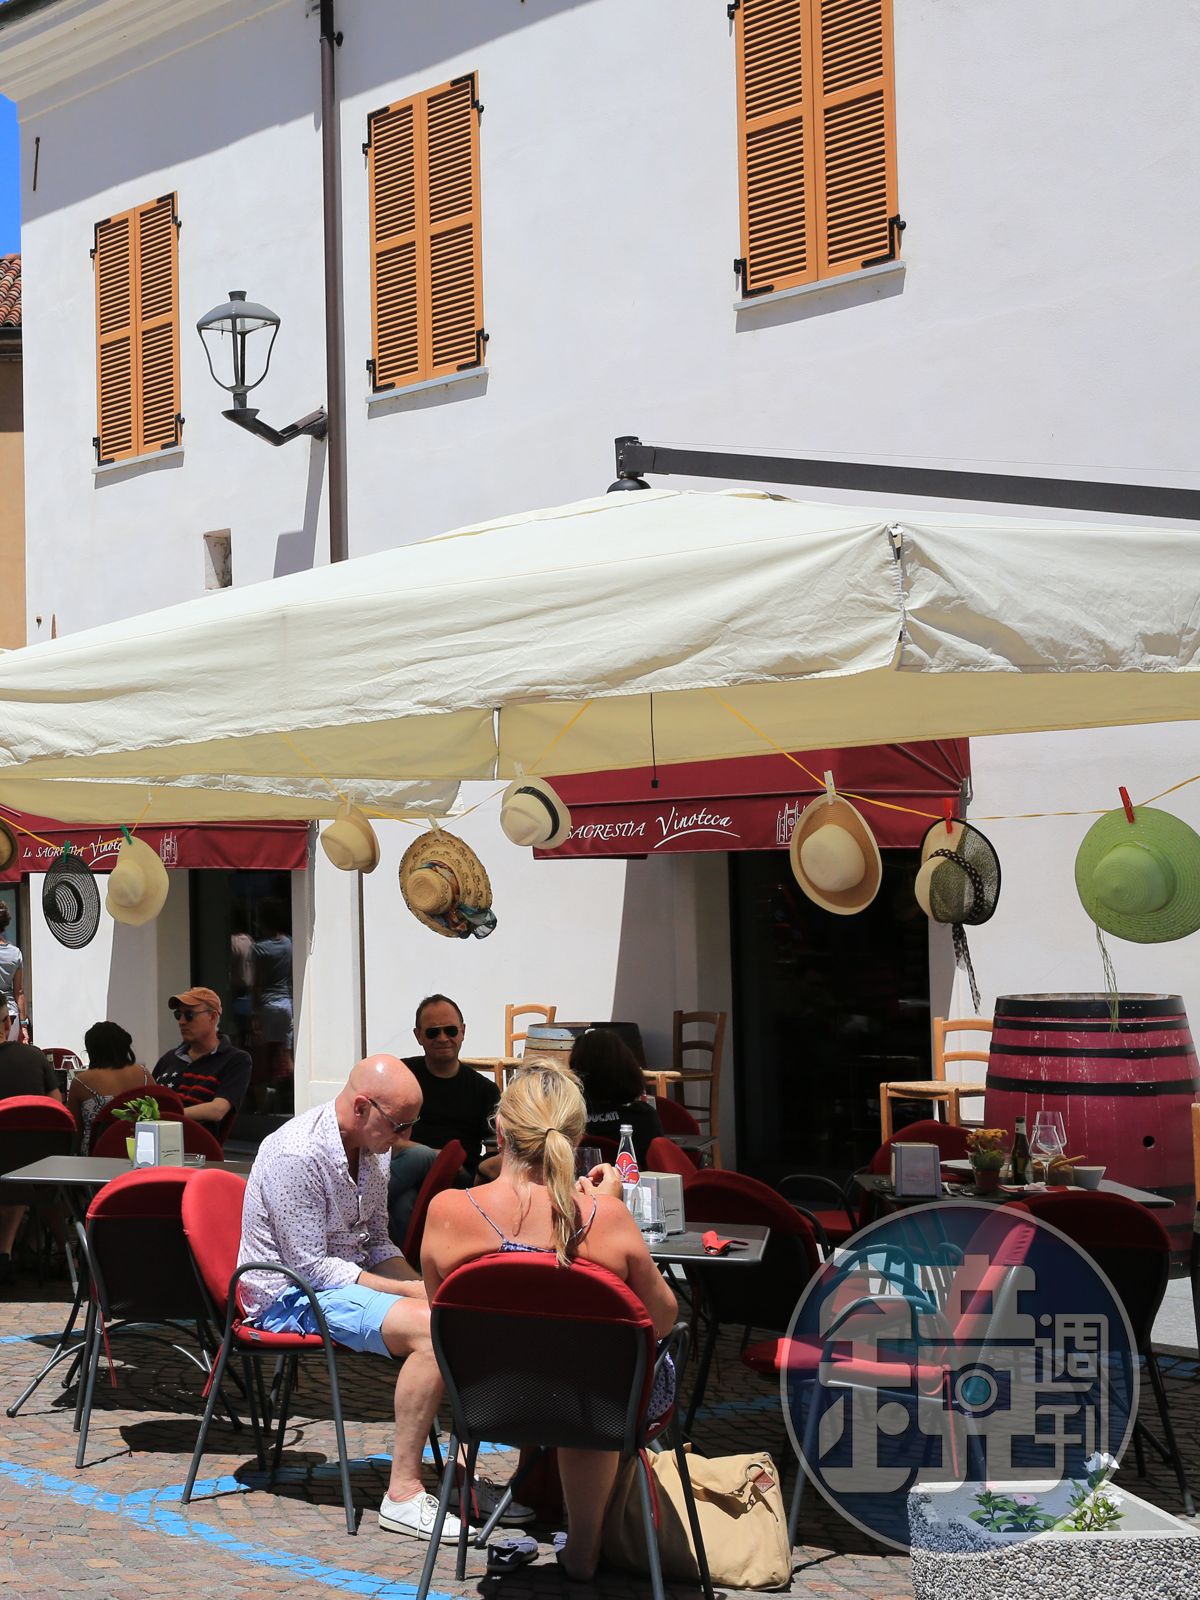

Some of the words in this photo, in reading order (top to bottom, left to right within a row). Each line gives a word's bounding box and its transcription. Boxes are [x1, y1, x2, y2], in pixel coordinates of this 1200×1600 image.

[567, 821, 646, 841] SACRESTIA
[656, 807, 732, 836] Vinoteca
[36, 845, 83, 858] SACRETIA
